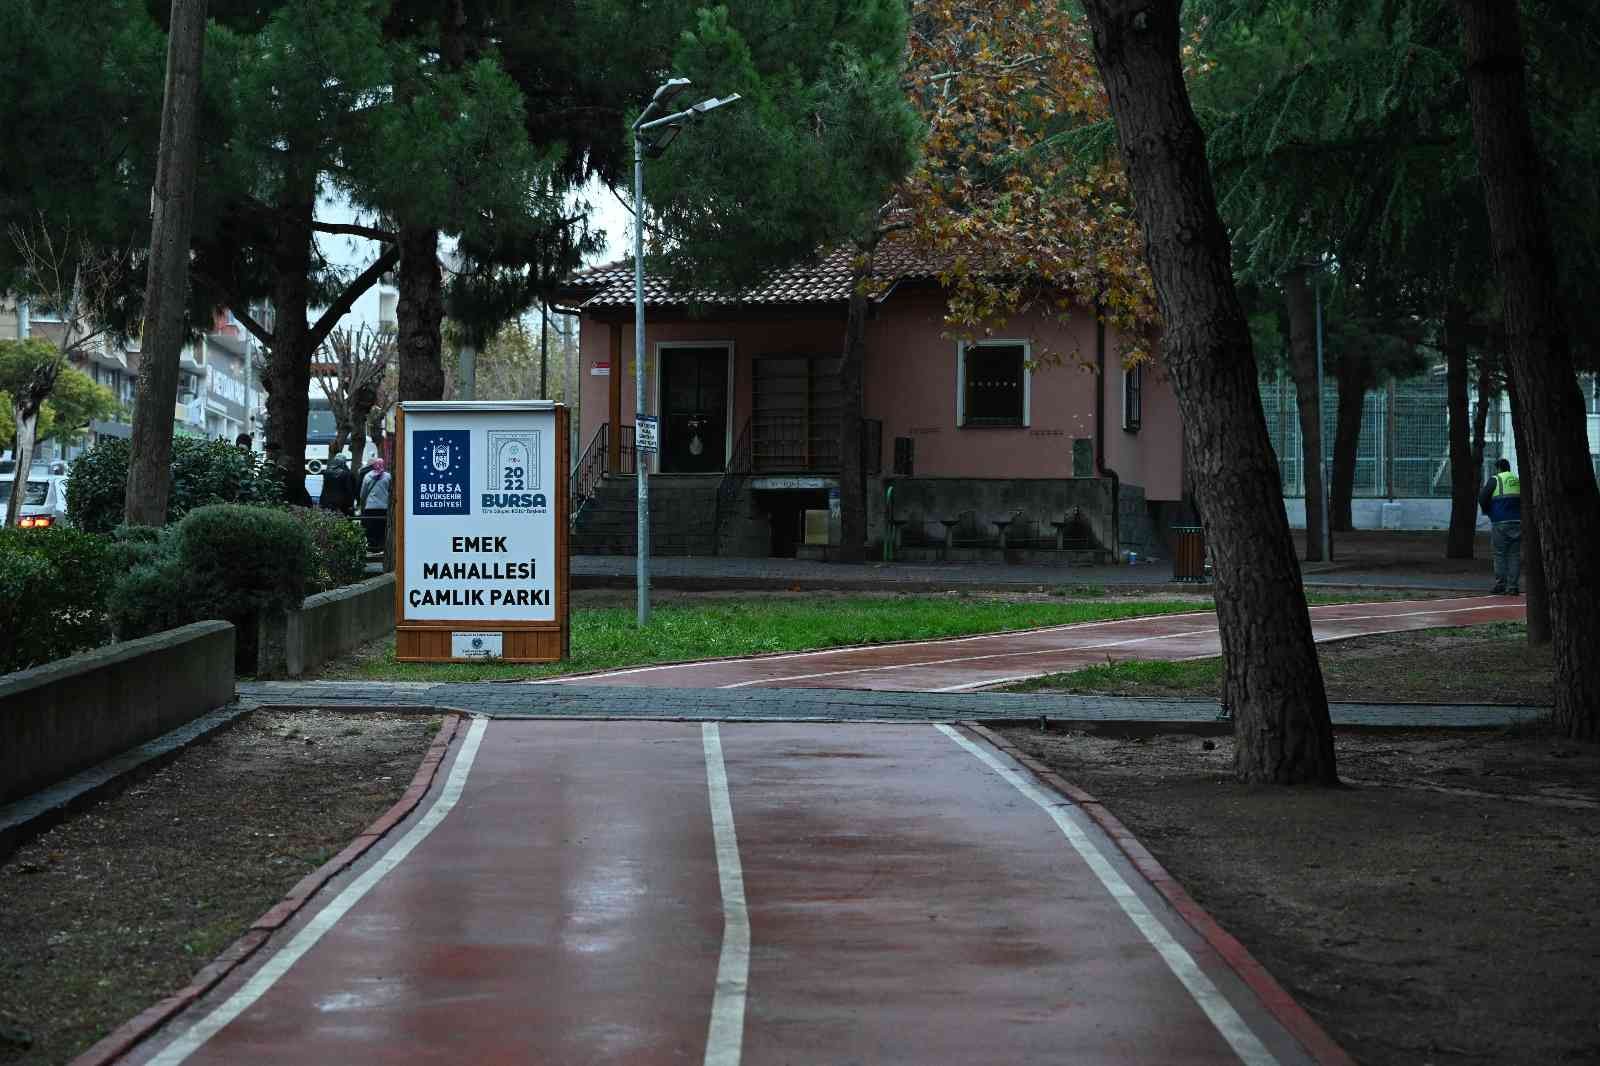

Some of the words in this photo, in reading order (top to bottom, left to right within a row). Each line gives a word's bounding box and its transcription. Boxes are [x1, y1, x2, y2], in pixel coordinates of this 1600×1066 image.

[504, 467, 524, 478] 20
[420, 483, 462, 493] BURSA
[504, 479, 524, 490] 22
[481, 493, 547, 507] BURSA
[452, 536, 508, 553] EMEK
[423, 558, 536, 580] MAHALLESİ
[409, 589, 485, 607] ÇAMLIK
[490, 589, 550, 606] PARKI
